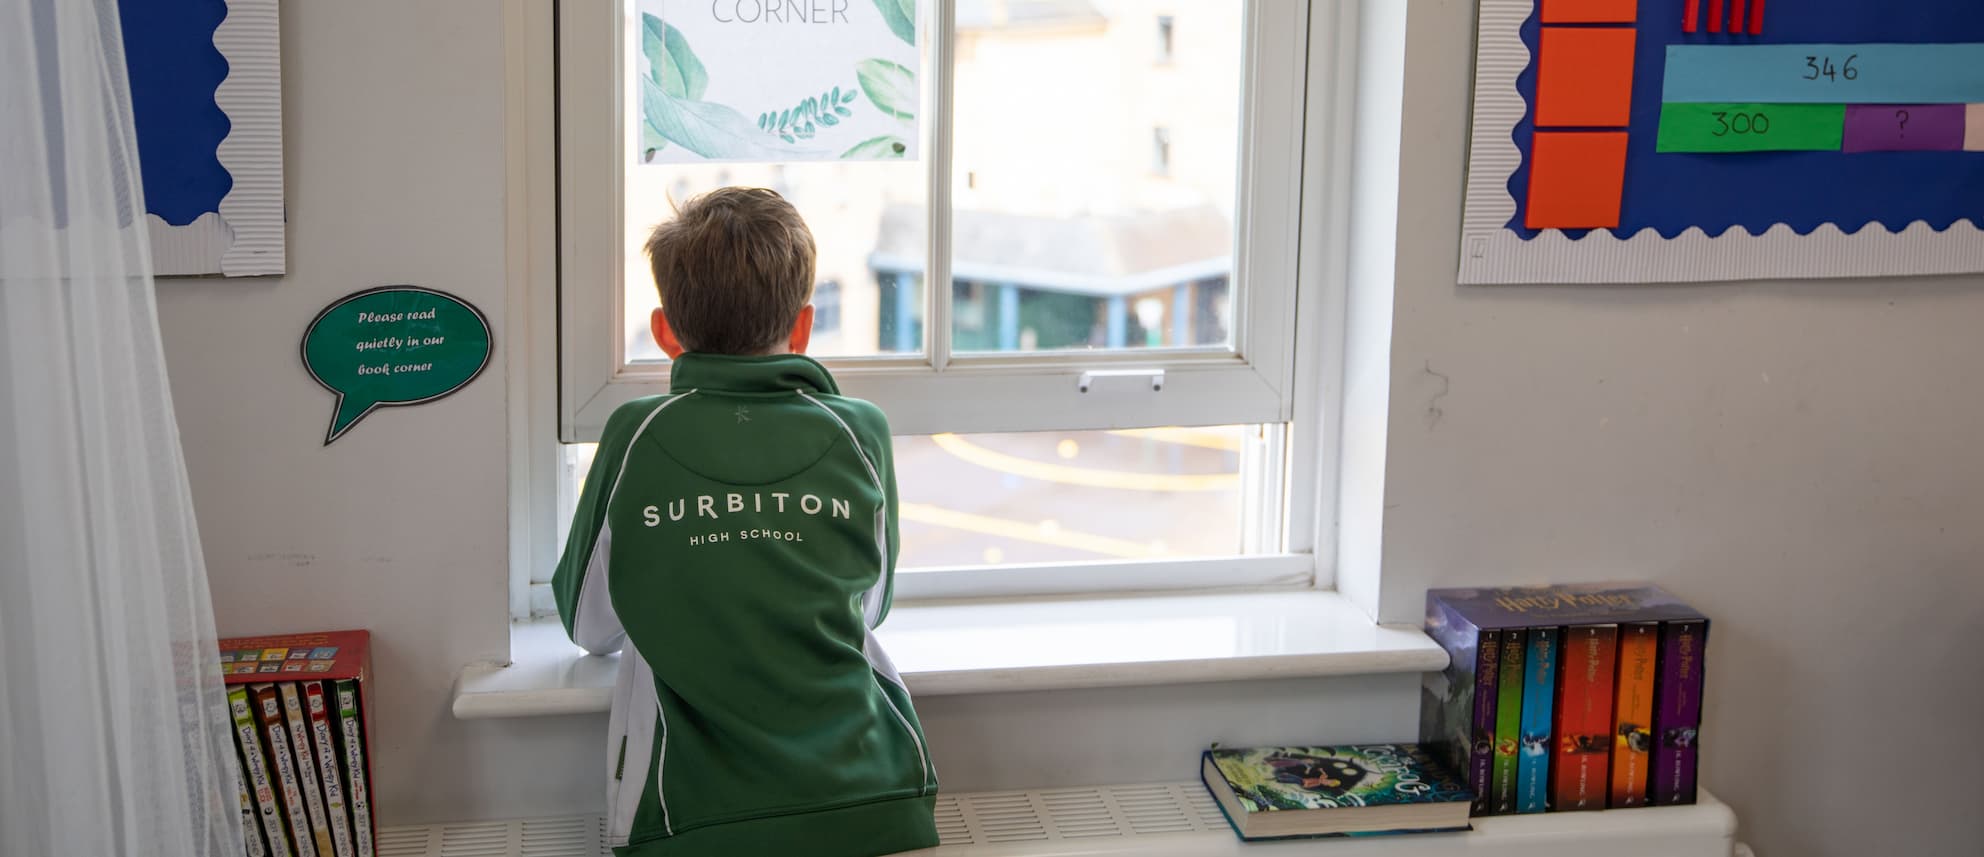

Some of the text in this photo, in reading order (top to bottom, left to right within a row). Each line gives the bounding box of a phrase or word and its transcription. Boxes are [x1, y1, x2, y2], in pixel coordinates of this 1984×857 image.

[712, 0, 849, 24] CORNER
[1802, 54, 1859, 83] 346
[1711, 111, 1769, 137] 300
[358, 307, 436, 324] Please read
[356, 335, 445, 352] quietly in our
[358, 362, 433, 376] book corner
[642, 492, 850, 527] SURBITON
[690, 528, 804, 546] HIGH SCHOOL
